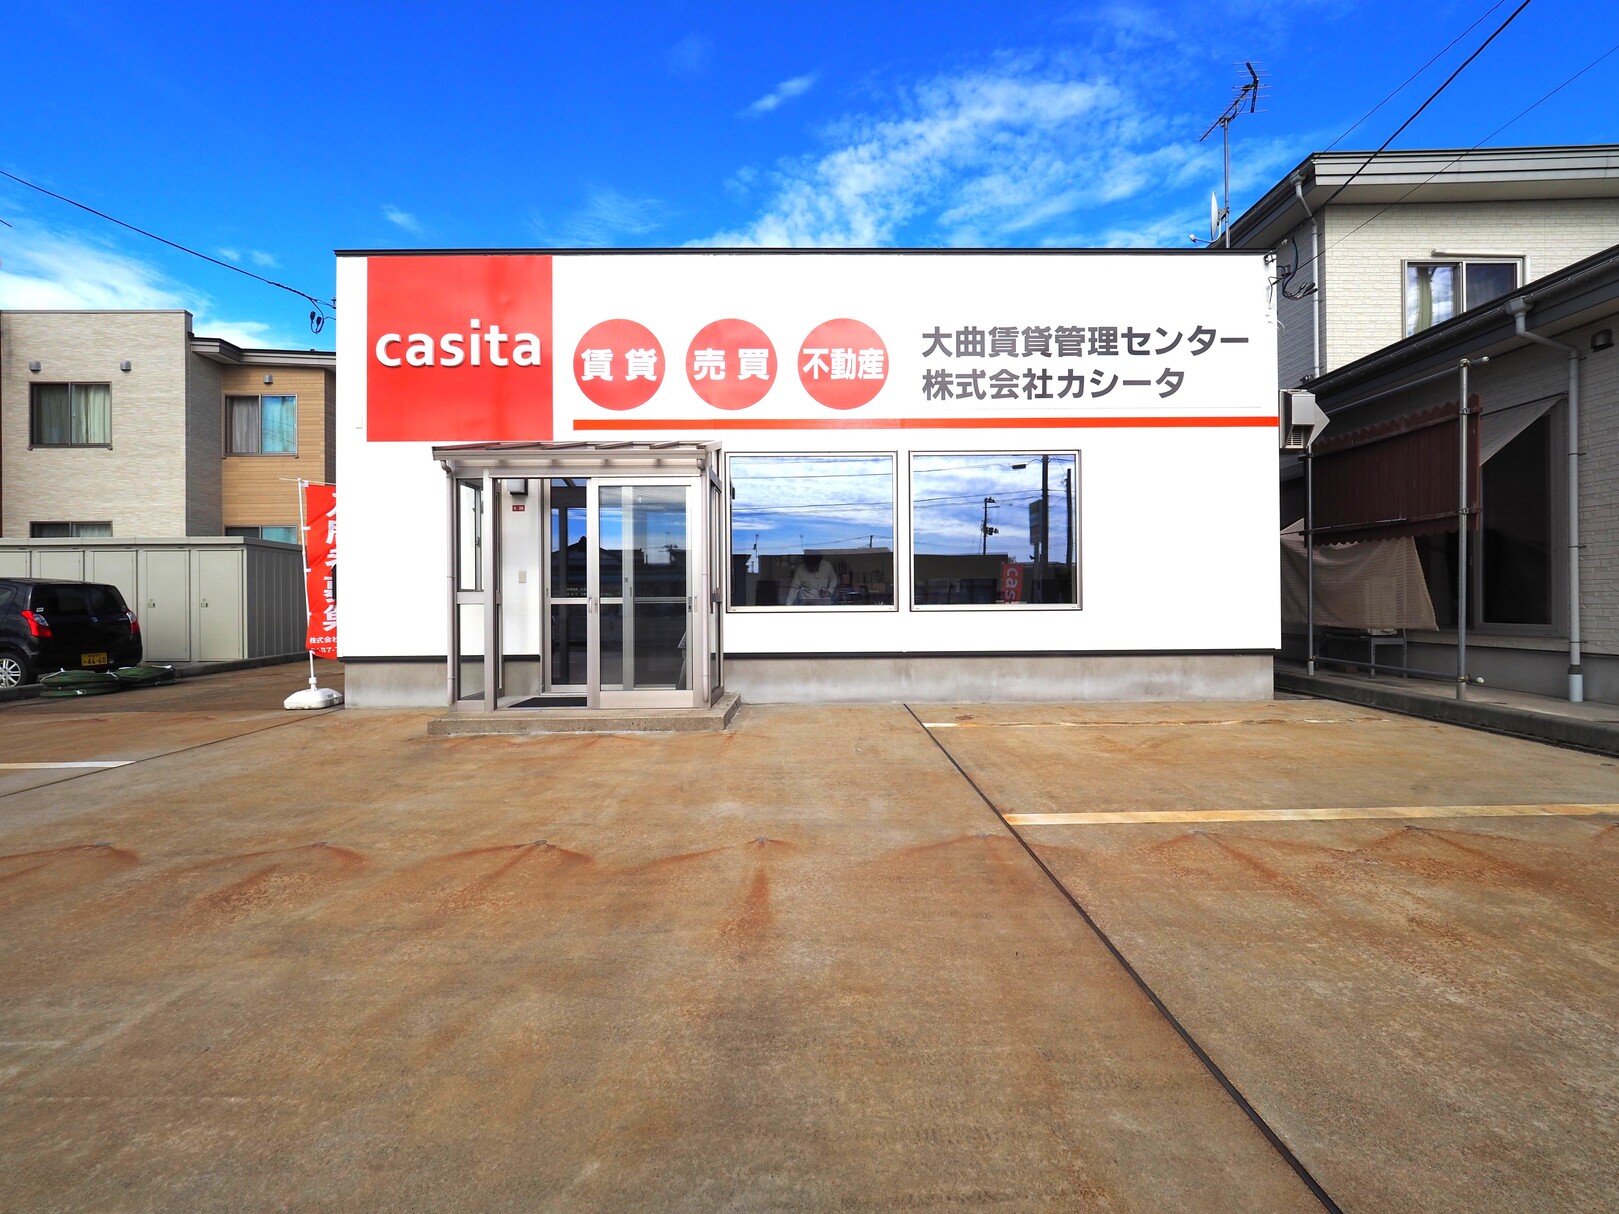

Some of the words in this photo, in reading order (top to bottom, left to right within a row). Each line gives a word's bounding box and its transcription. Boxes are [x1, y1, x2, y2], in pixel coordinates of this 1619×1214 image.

[375, 318, 541, 368] casita
[921, 325, 1249, 358] 大曲賃貸管理センター
[580, 348, 658, 382] 賃貸
[693, 347, 770, 382] 売買
[802, 347, 886, 381] 不動産
[922, 367, 1185, 401] 株式会社カシータ
